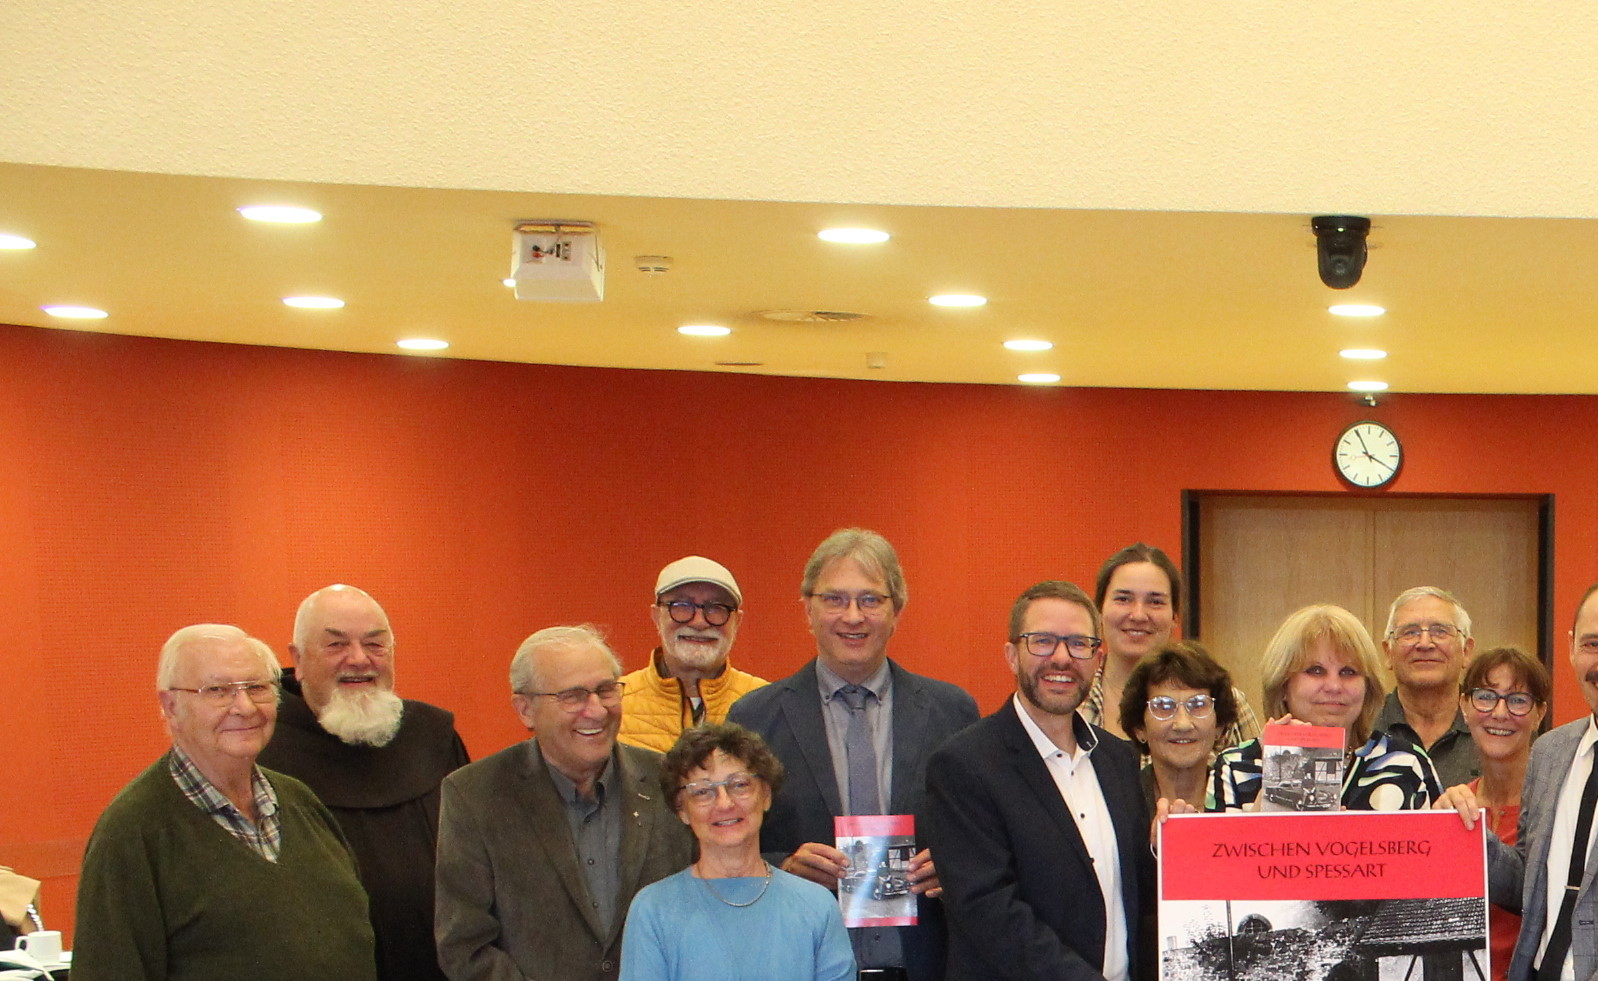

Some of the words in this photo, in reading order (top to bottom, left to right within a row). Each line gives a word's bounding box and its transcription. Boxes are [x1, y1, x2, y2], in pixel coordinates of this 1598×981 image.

[1212, 842, 1310, 857] ZWISCHEN
[1315, 840, 1432, 858] VOGELSBERG
[1258, 865, 1301, 879] UND
[1306, 863, 1387, 878] SPESSART
